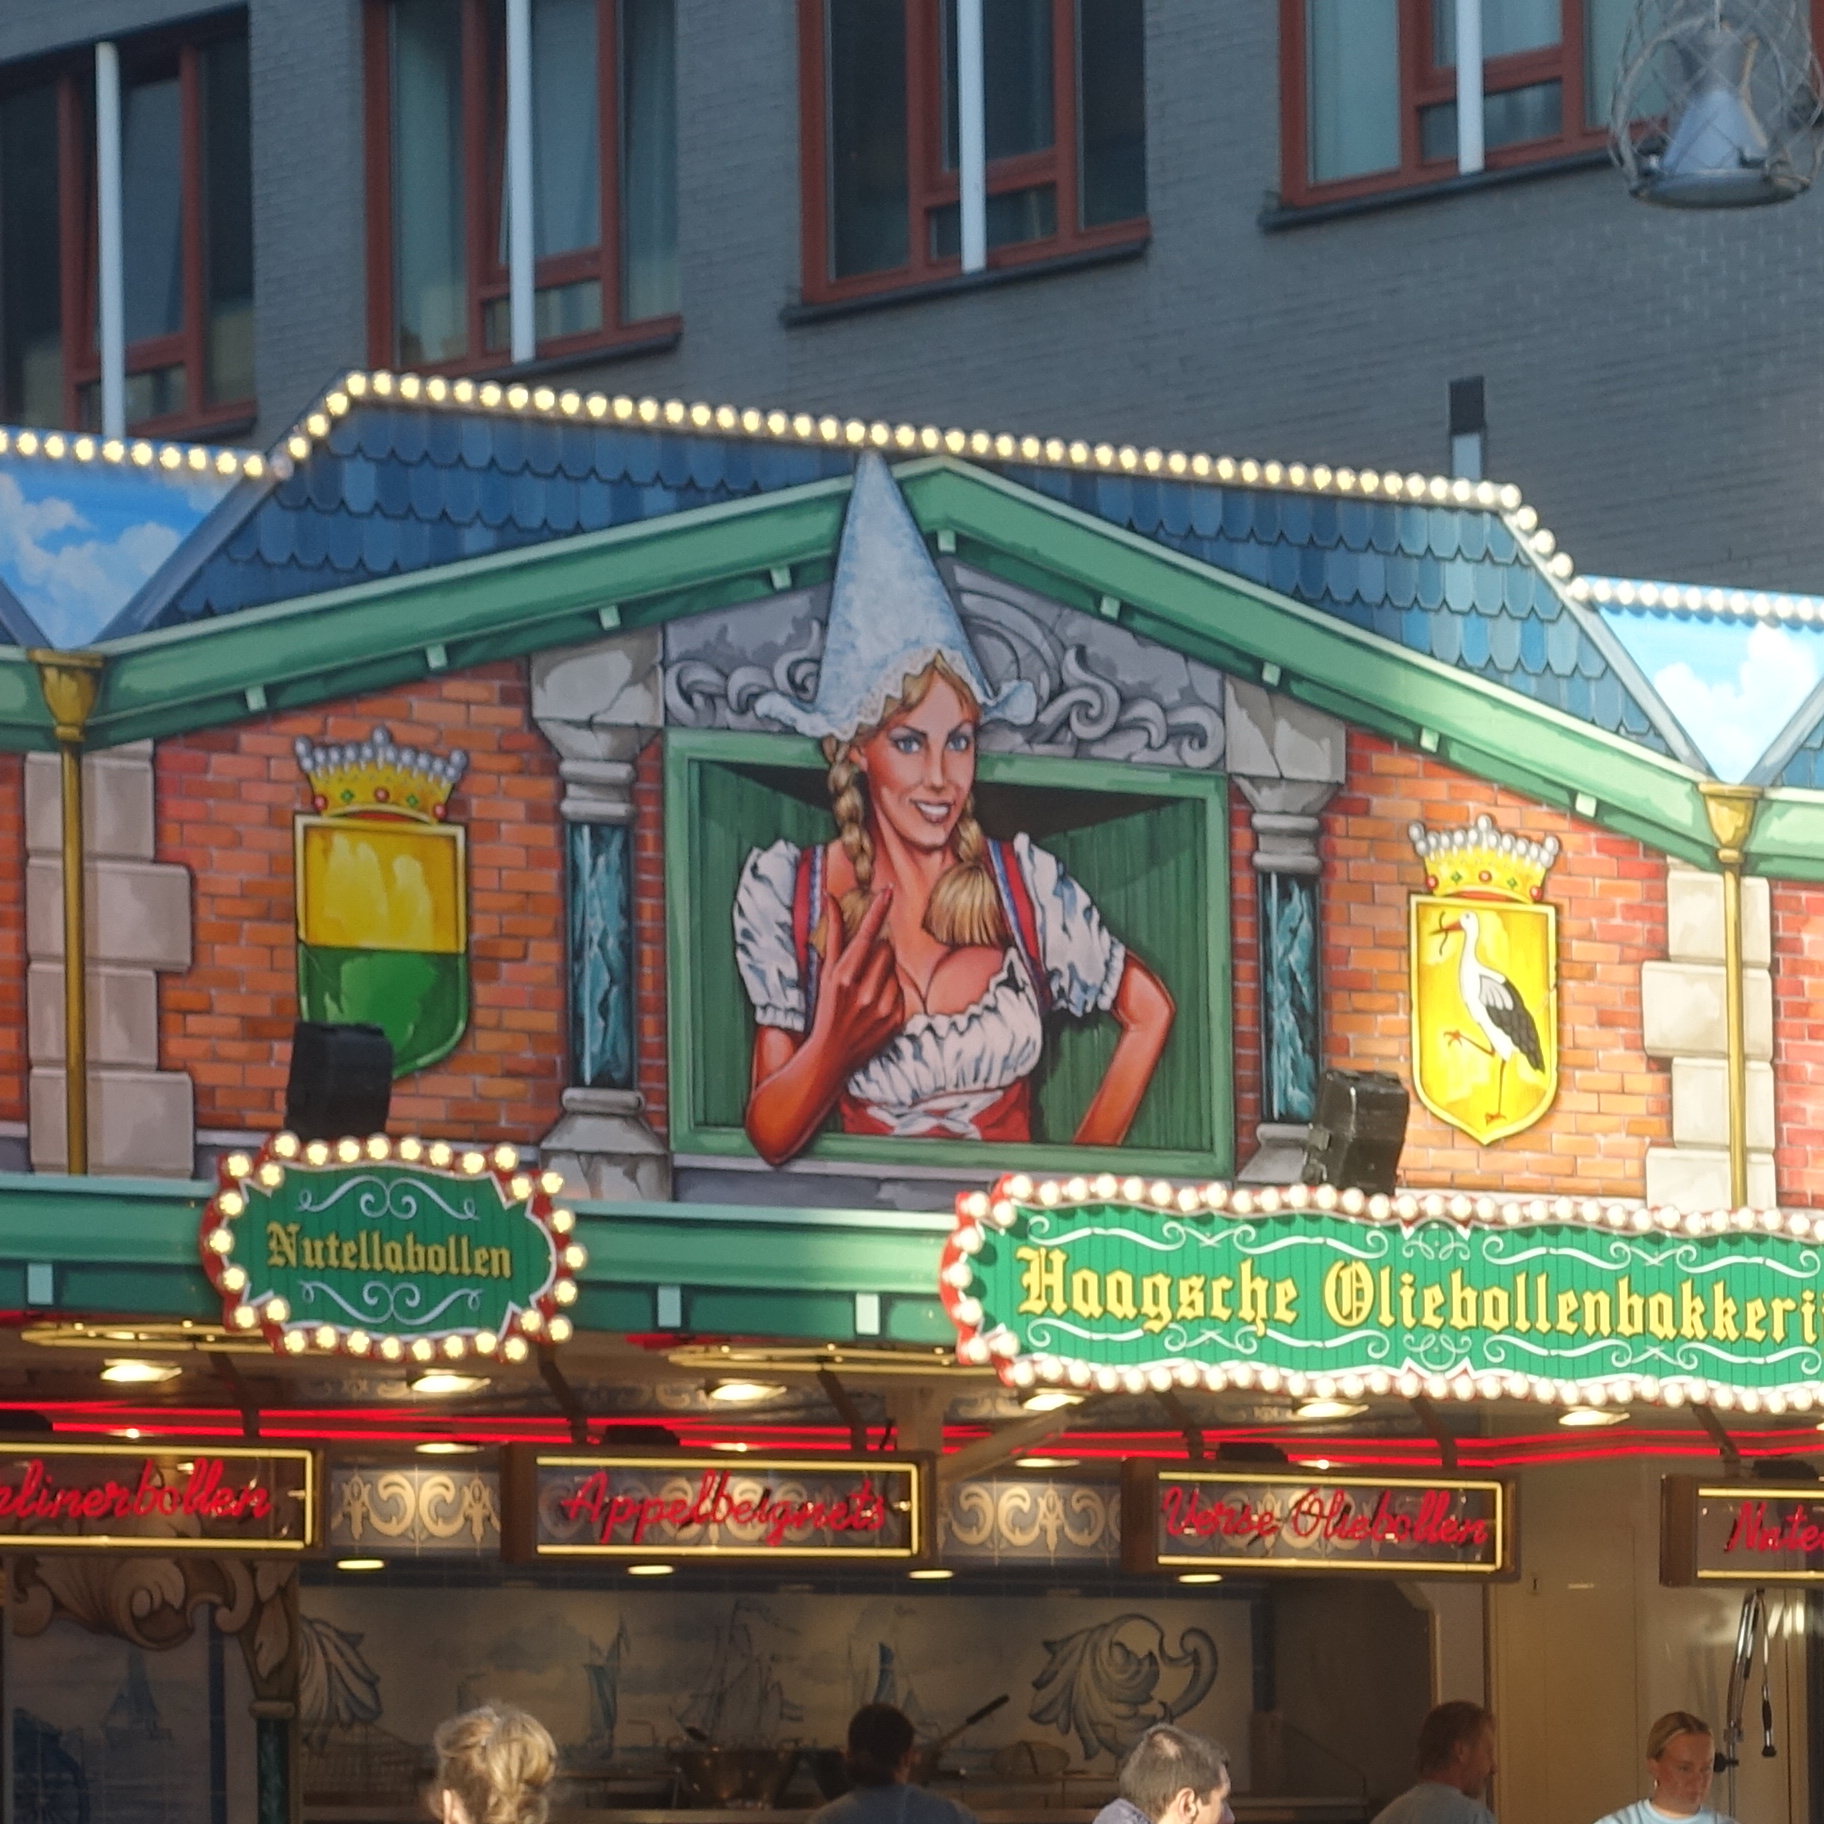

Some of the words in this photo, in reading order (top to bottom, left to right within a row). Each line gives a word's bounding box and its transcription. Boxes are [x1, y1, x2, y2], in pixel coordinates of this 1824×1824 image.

[266, 1220, 513, 1280] Nutellabollen
[1015, 1245, 1299, 1339] Haagsche
[560, 1468, 886, 1546] Appelbeignets
[1161, 1486, 1280, 1537] Verse
[1280, 1487, 1489, 1546] Oliebollen
